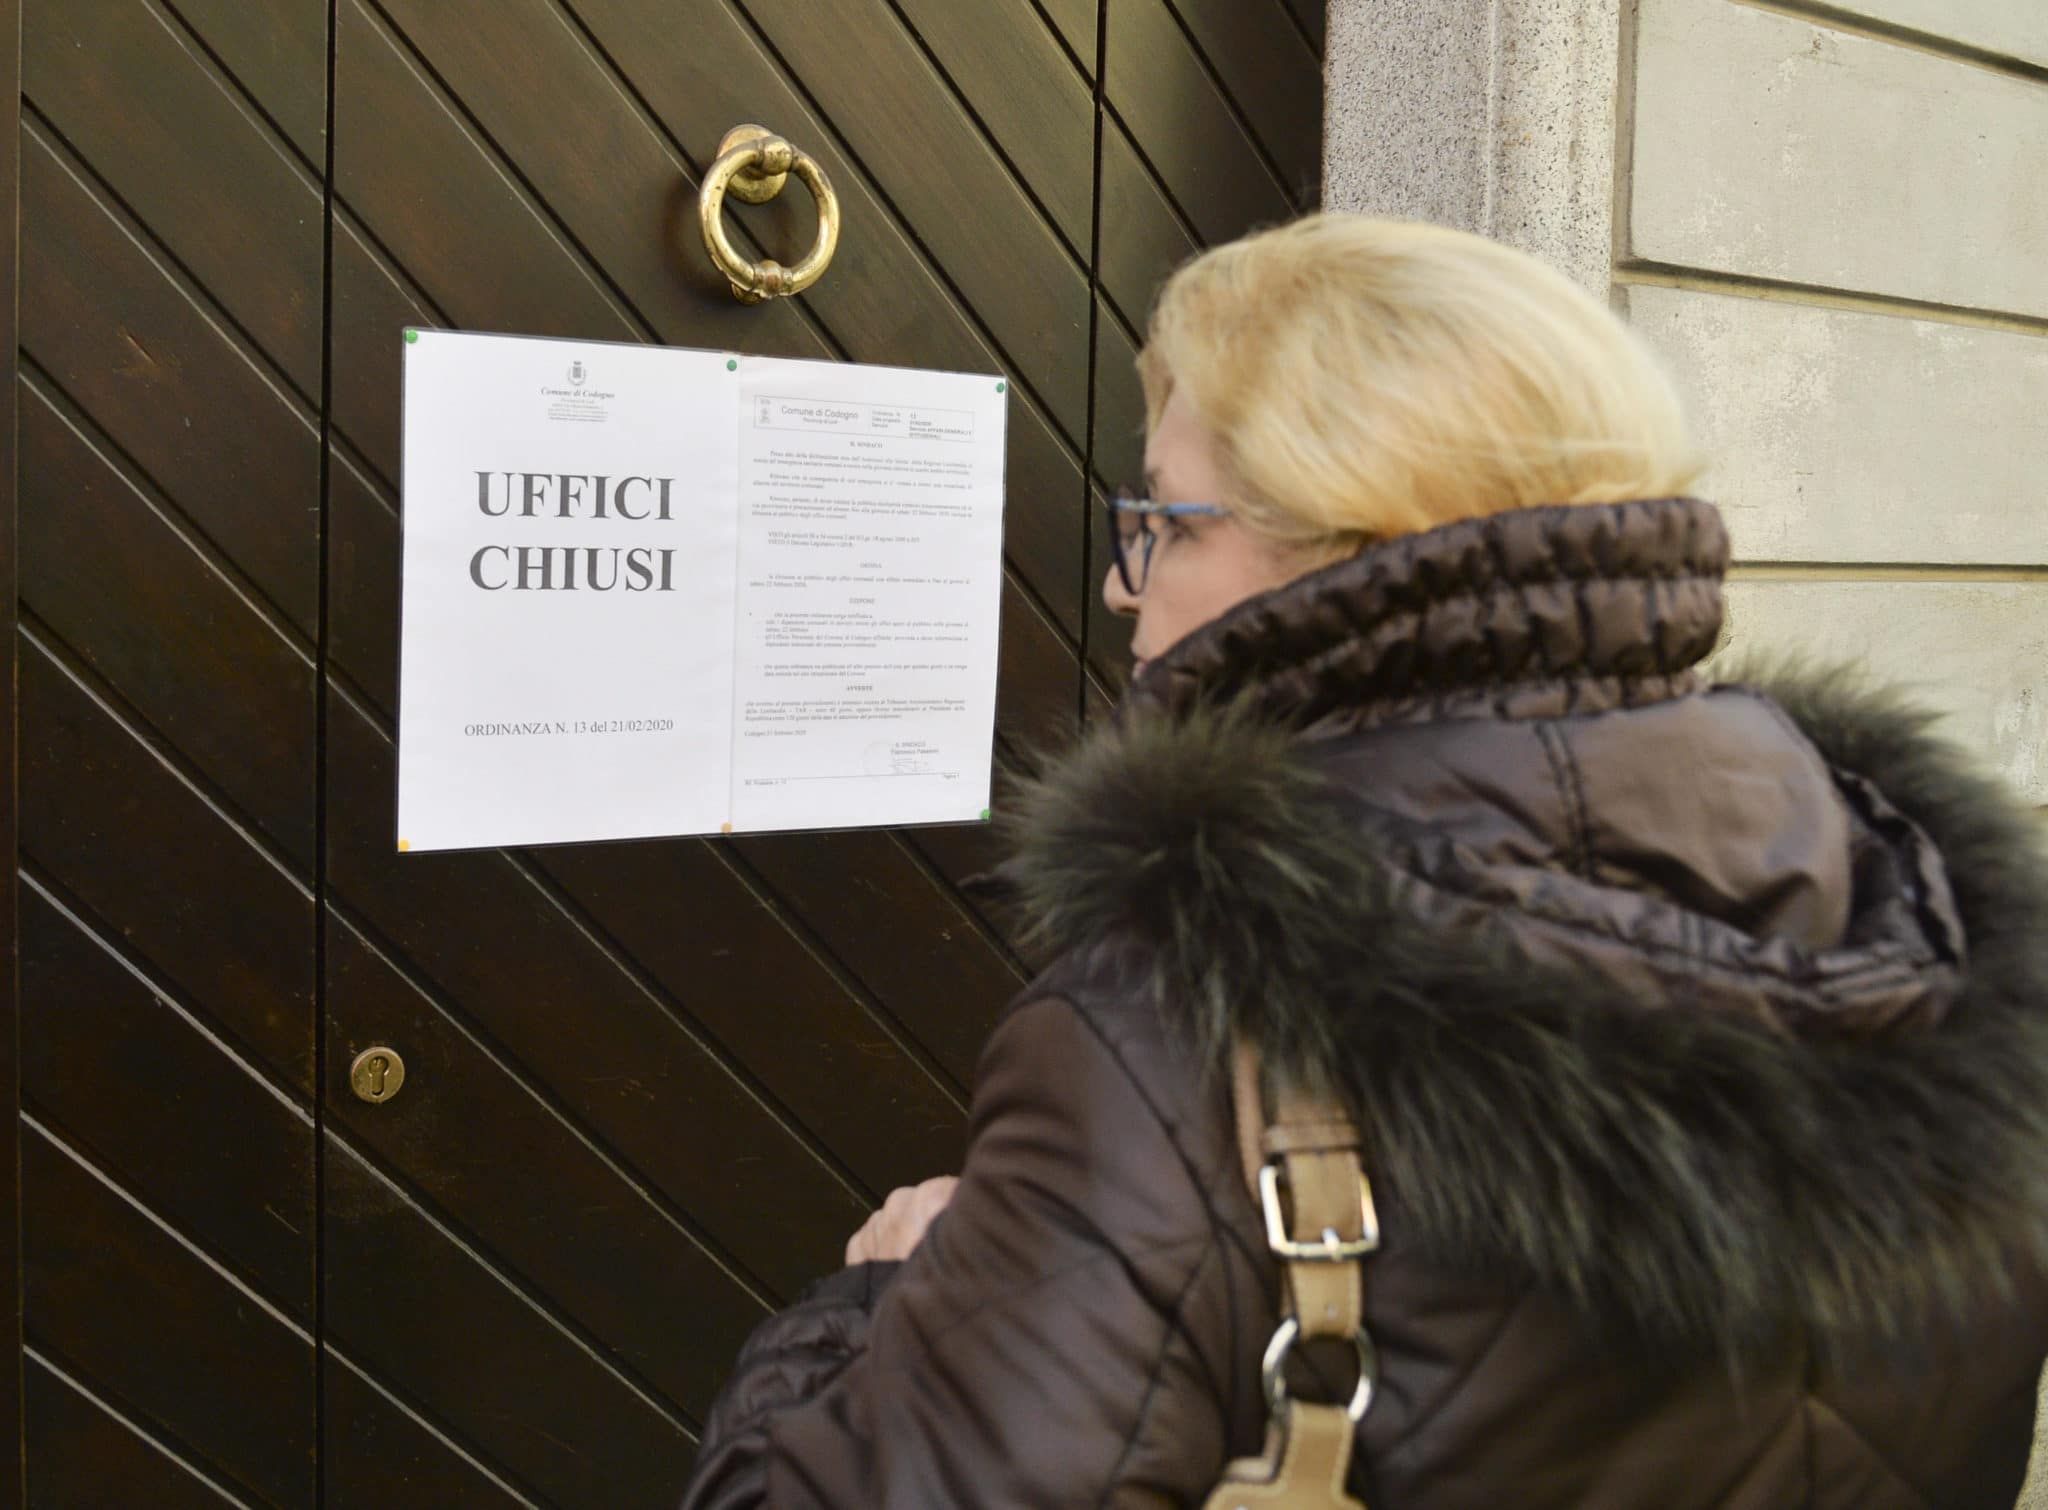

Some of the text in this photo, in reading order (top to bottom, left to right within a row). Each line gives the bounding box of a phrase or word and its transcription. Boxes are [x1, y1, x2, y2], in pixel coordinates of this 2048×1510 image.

[781, 405, 814, 417] Comune
[815, 407, 823, 417] di
[824, 408, 859, 421] Codogno
[474, 471, 676, 521] UFFICI
[469, 545, 677, 592] CHIUSI
[465, 719, 674, 737] ORDINANZA N. 13 del 21/02/2020
